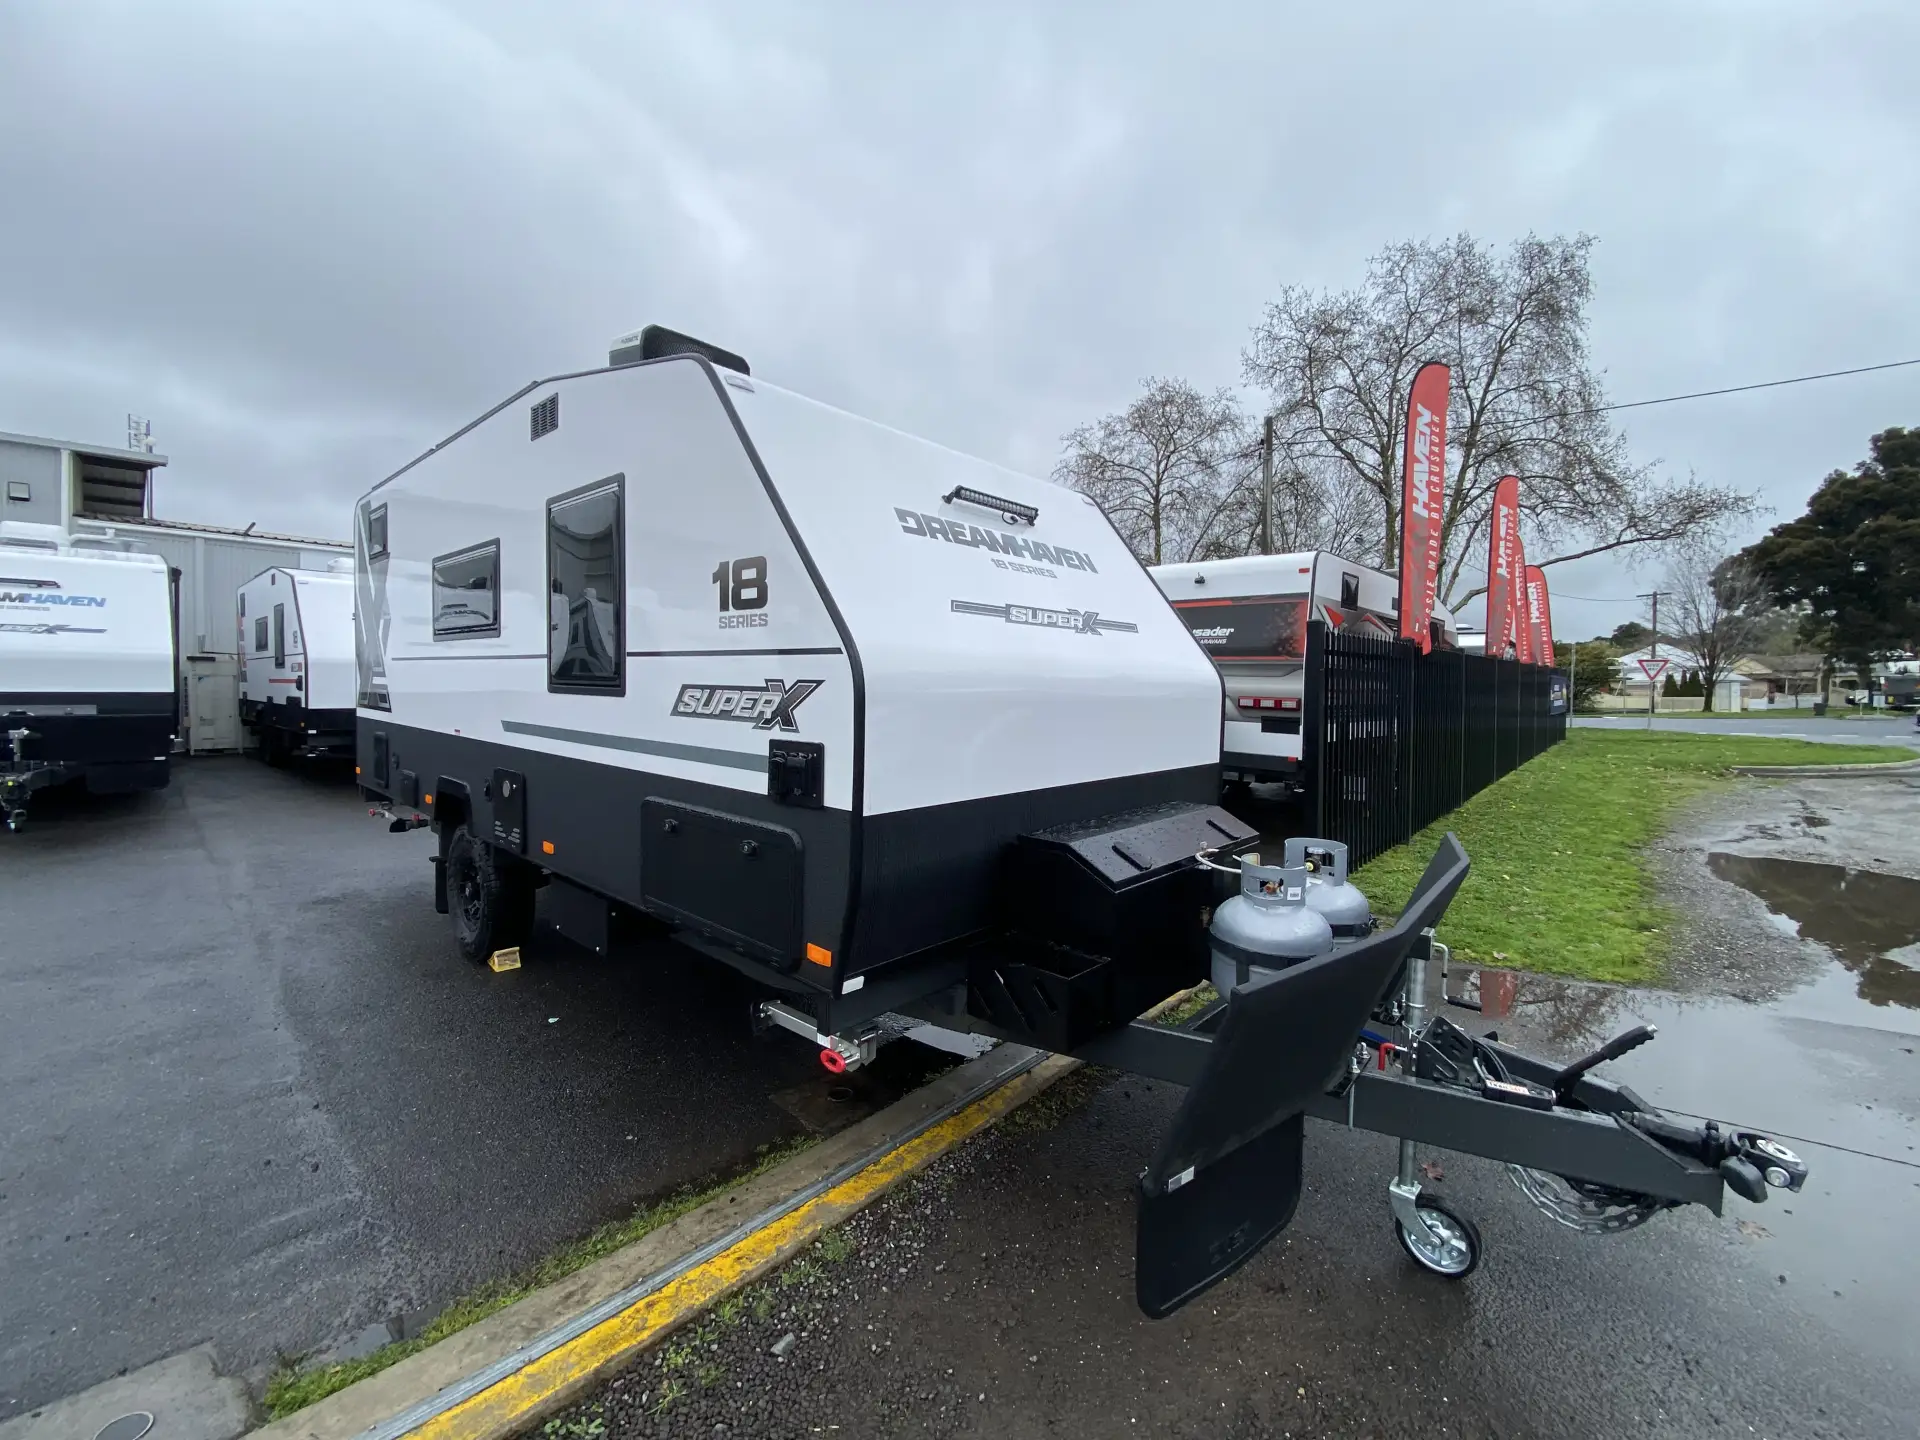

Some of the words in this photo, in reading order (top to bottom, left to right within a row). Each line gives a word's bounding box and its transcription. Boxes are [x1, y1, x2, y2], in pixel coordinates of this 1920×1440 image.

[1412, 403, 1432, 518] HAVEN
[1430, 414, 1441, 493] CRUSADER
[1430, 502, 1440, 520] BY
[893, 506, 1099, 574] DREAMHAVEN
[1428, 529, 1439, 570] MADE
[712, 555, 769, 612] 18
[1007, 561, 1058, 579] SERIES
[0, 592, 107, 607] MHAVEN
[718, 613, 769, 629] SERIES
[1192, 626, 1235, 637] sader
